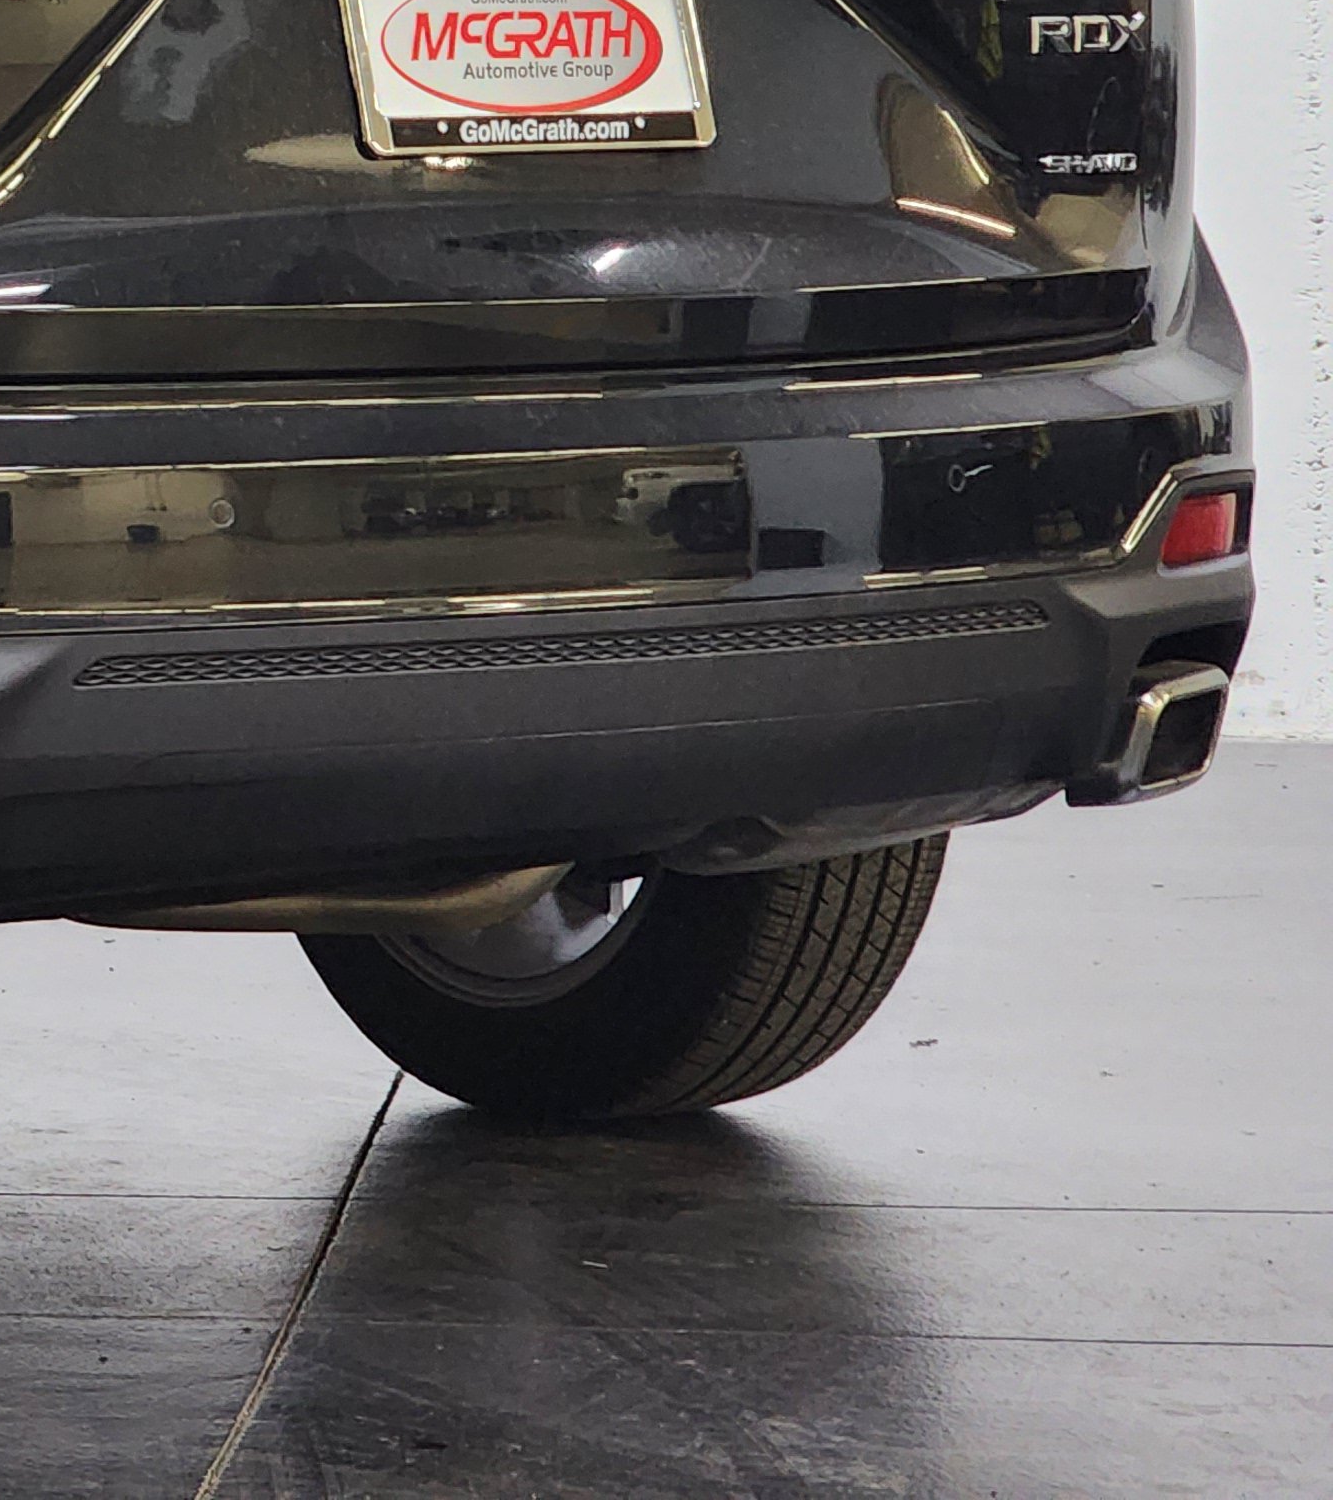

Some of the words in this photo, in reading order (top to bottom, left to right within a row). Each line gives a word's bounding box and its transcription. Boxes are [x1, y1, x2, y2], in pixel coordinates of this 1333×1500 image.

[1030, 11, 1146, 54] RDX
[463, 62, 559, 80] Automotive
[563, 62, 614, 81] Group
[459, 118, 630, 143] GoMcGrath.com
